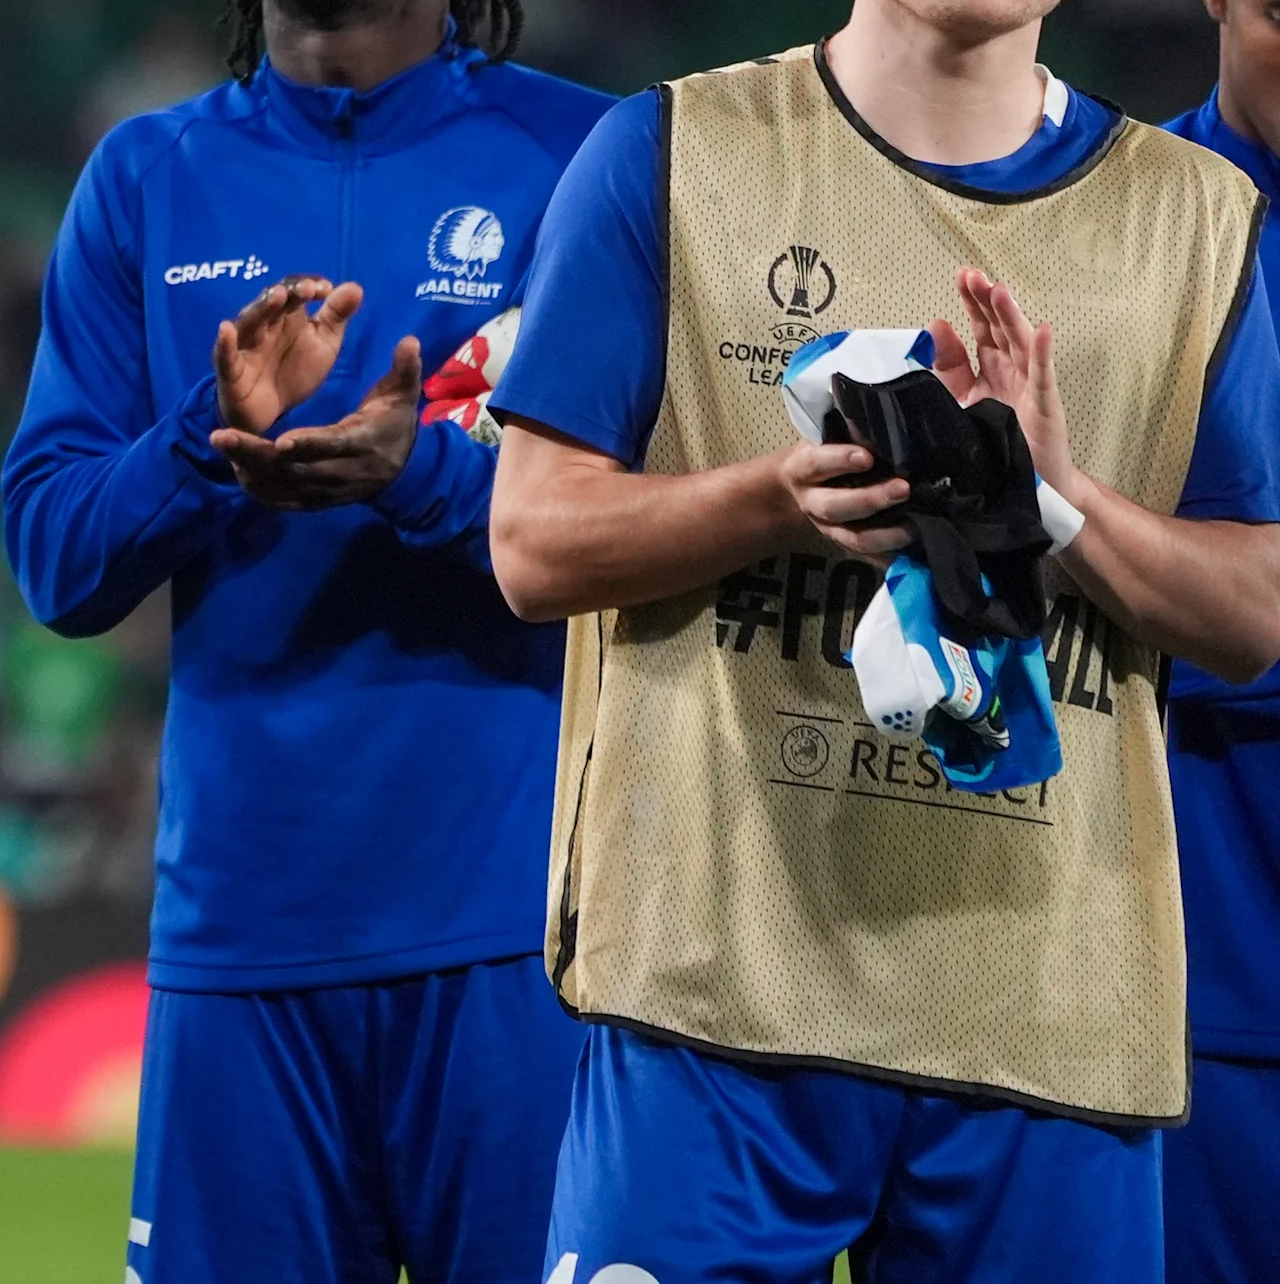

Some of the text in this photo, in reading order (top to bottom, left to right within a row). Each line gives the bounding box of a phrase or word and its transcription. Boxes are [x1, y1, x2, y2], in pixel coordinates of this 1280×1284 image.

[164, 259, 245, 285] CRAFT
[415, 278, 504, 299] KAA GENT
